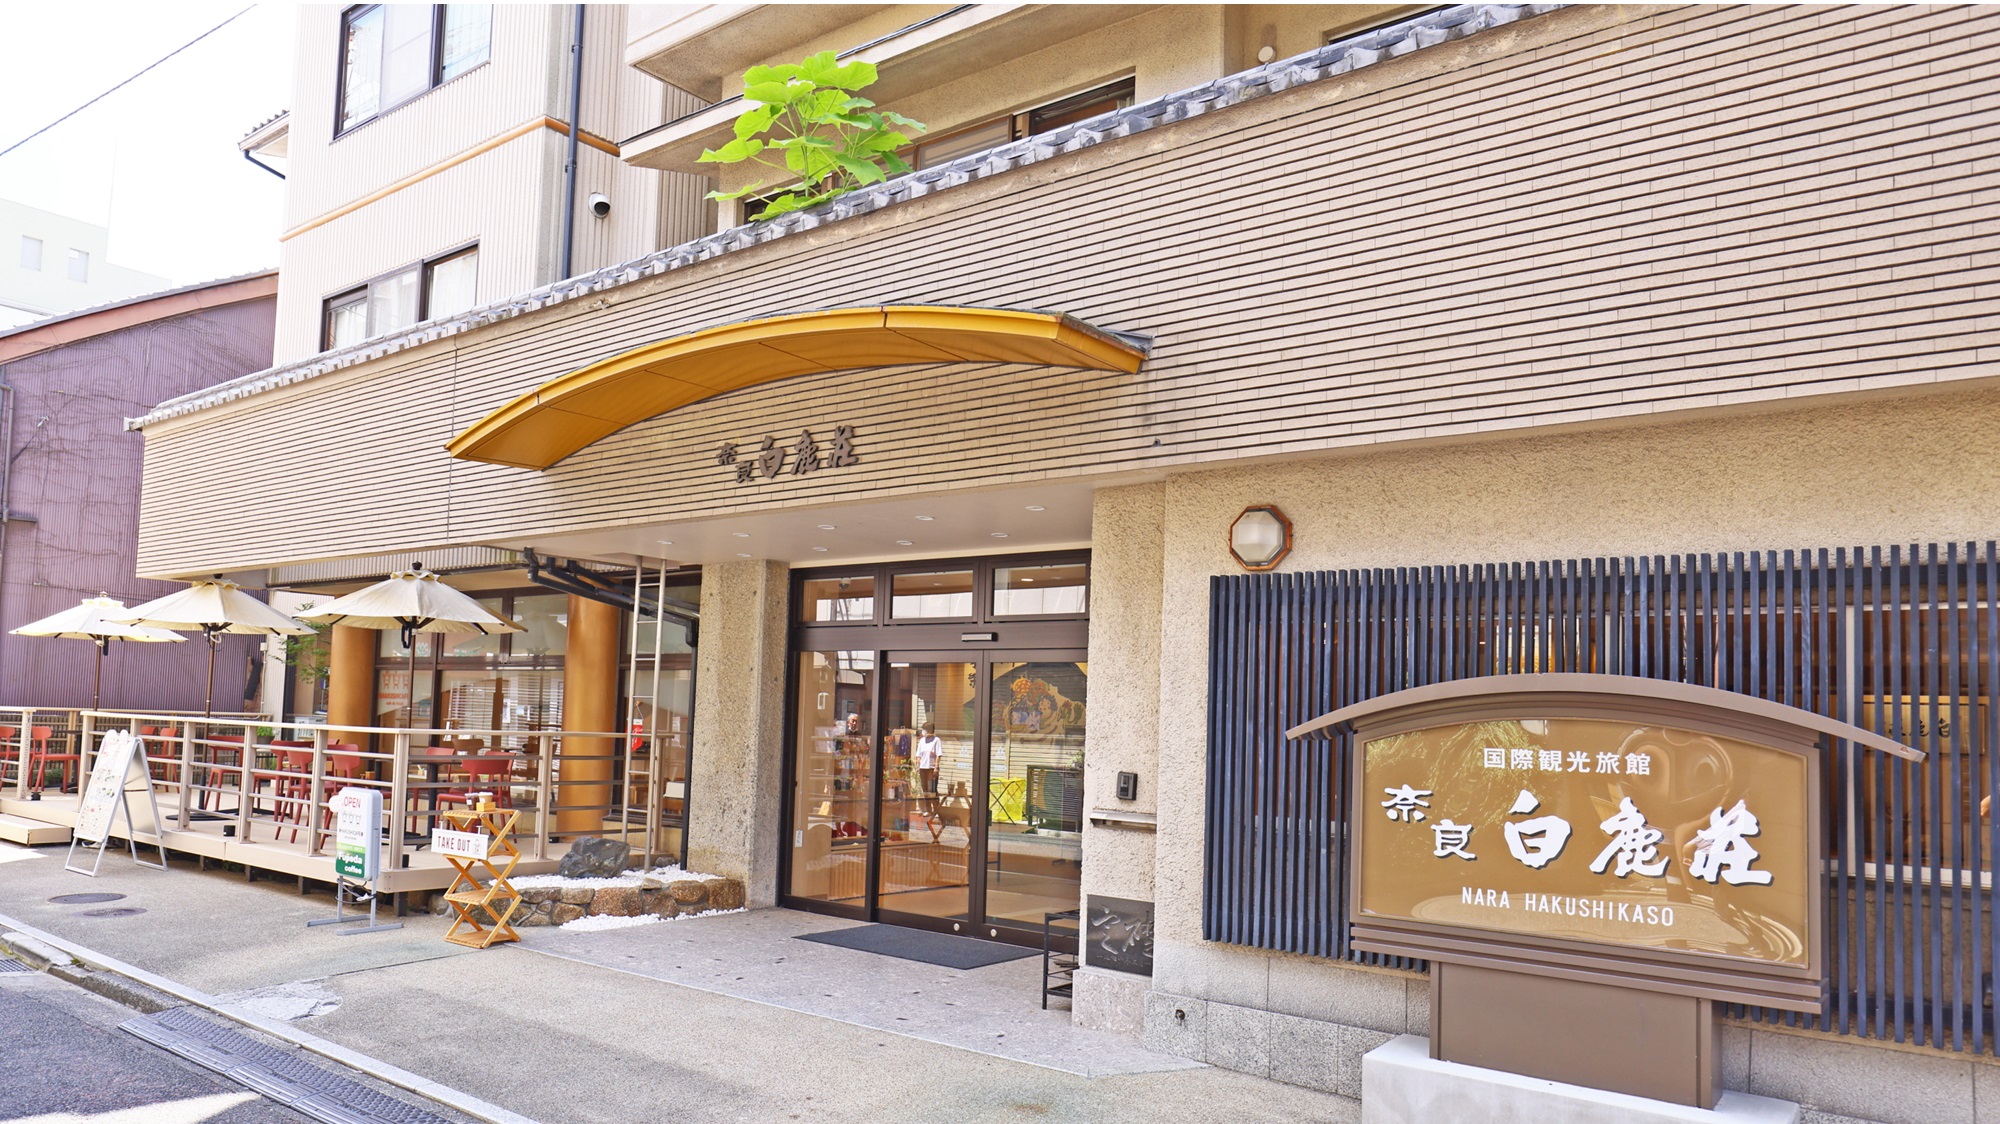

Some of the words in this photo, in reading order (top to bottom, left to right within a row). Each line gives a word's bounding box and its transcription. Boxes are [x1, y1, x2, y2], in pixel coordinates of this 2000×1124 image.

[1483, 747, 1651, 776] 国際観光旅館
[343, 796, 361, 808] OPEN
[437, 836, 454, 850] TAKE
[457, 838, 470, 851] OUT
[344, 865, 362, 874] coffee
[1462, 886, 1510, 909] NARA
[1525, 892, 1674, 927] HAKUSHIKASO
